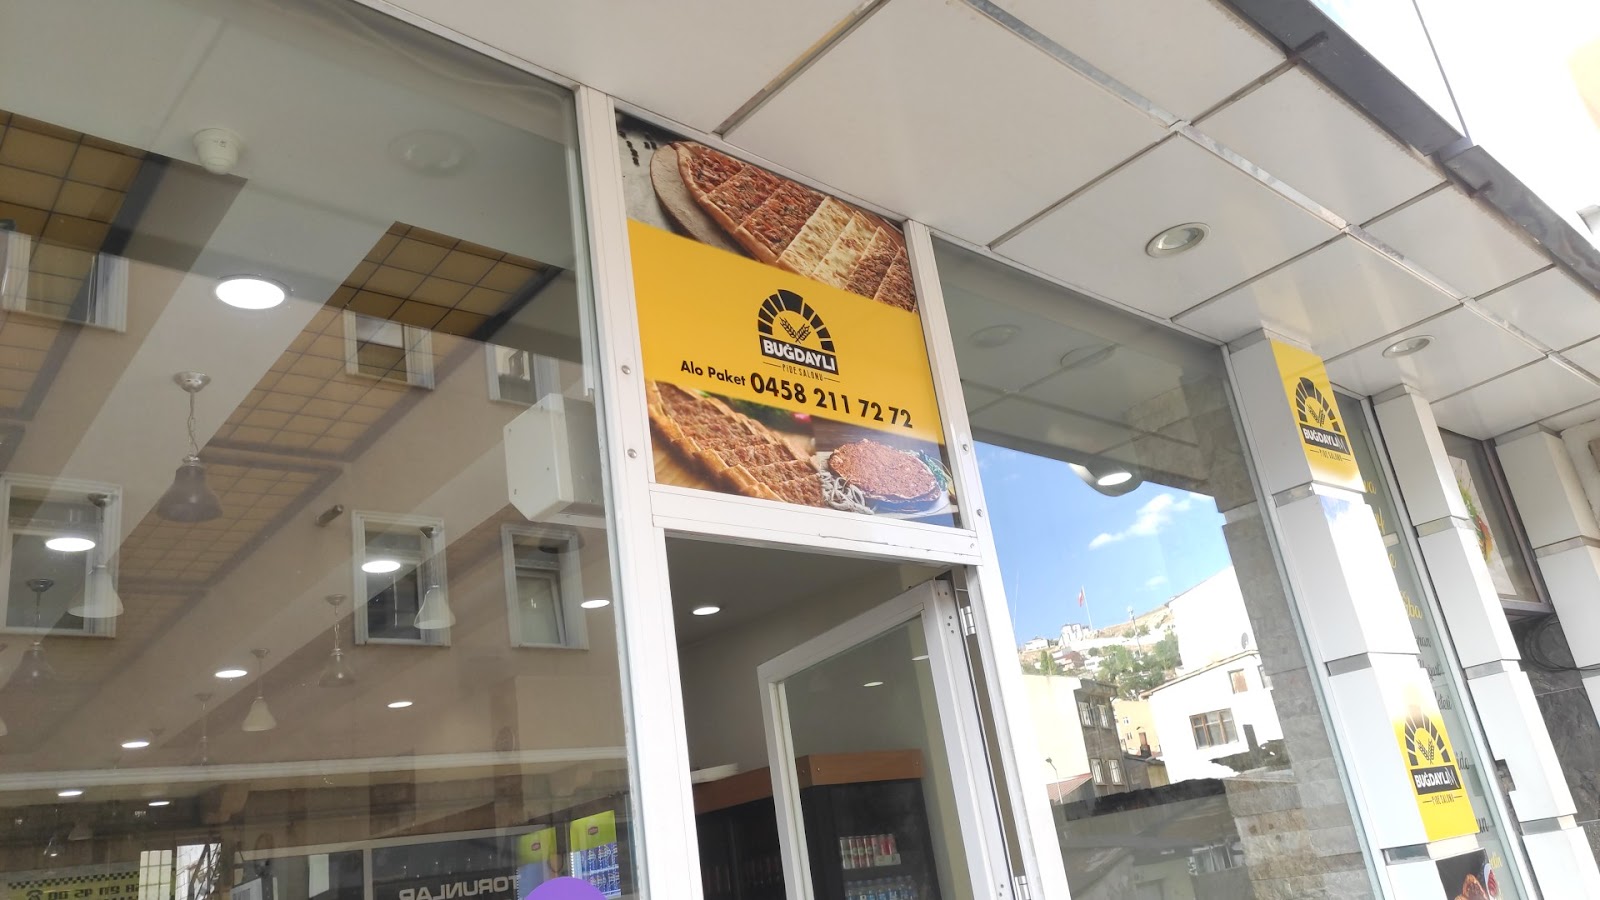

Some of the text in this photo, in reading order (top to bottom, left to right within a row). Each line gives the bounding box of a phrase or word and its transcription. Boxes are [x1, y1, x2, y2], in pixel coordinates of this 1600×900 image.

[763, 339, 836, 371] BUĞDAYLI
[799, 367, 824, 381] SALONU
[680, 360, 913, 429] Alo Paket 0458 211 72 72
